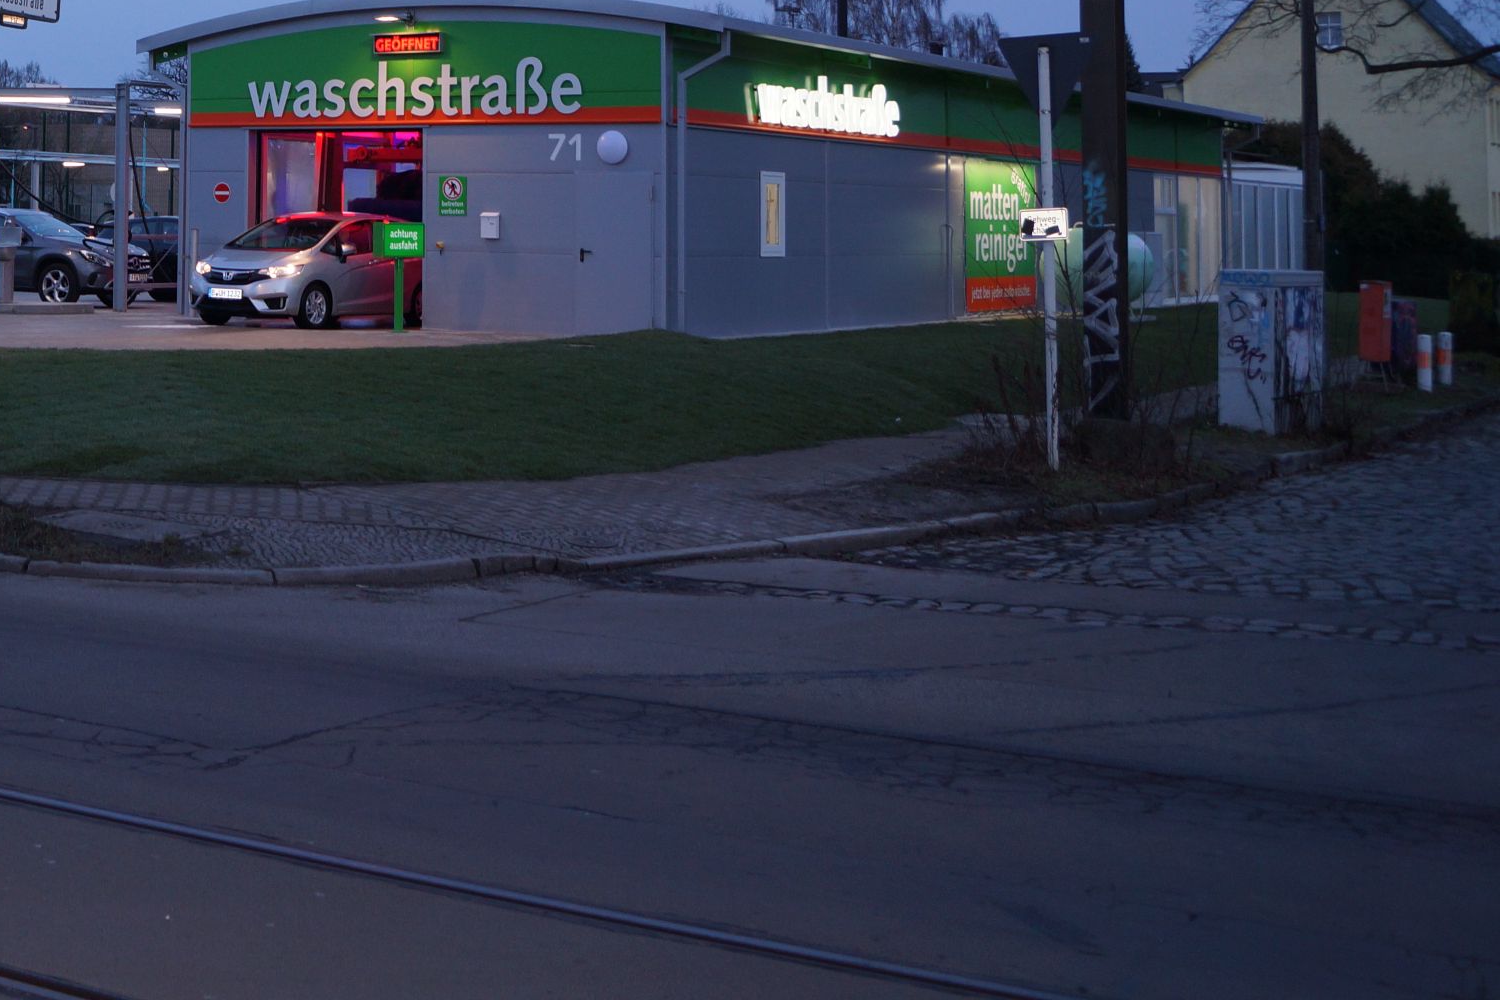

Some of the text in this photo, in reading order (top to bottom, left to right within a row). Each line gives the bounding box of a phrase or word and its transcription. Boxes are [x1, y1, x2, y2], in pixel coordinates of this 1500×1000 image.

[375, 35, 438, 52] GEÖFFNET
[247, 56, 583, 119] waschstraße
[756, 75, 900, 138] waschstraße
[548, 133, 582, 161] 71
[441, 207, 465, 215] verboten
[970, 183, 1019, 220] matten
[389, 241, 418, 251] ausfahrt
[390, 229, 418, 241] achtung
